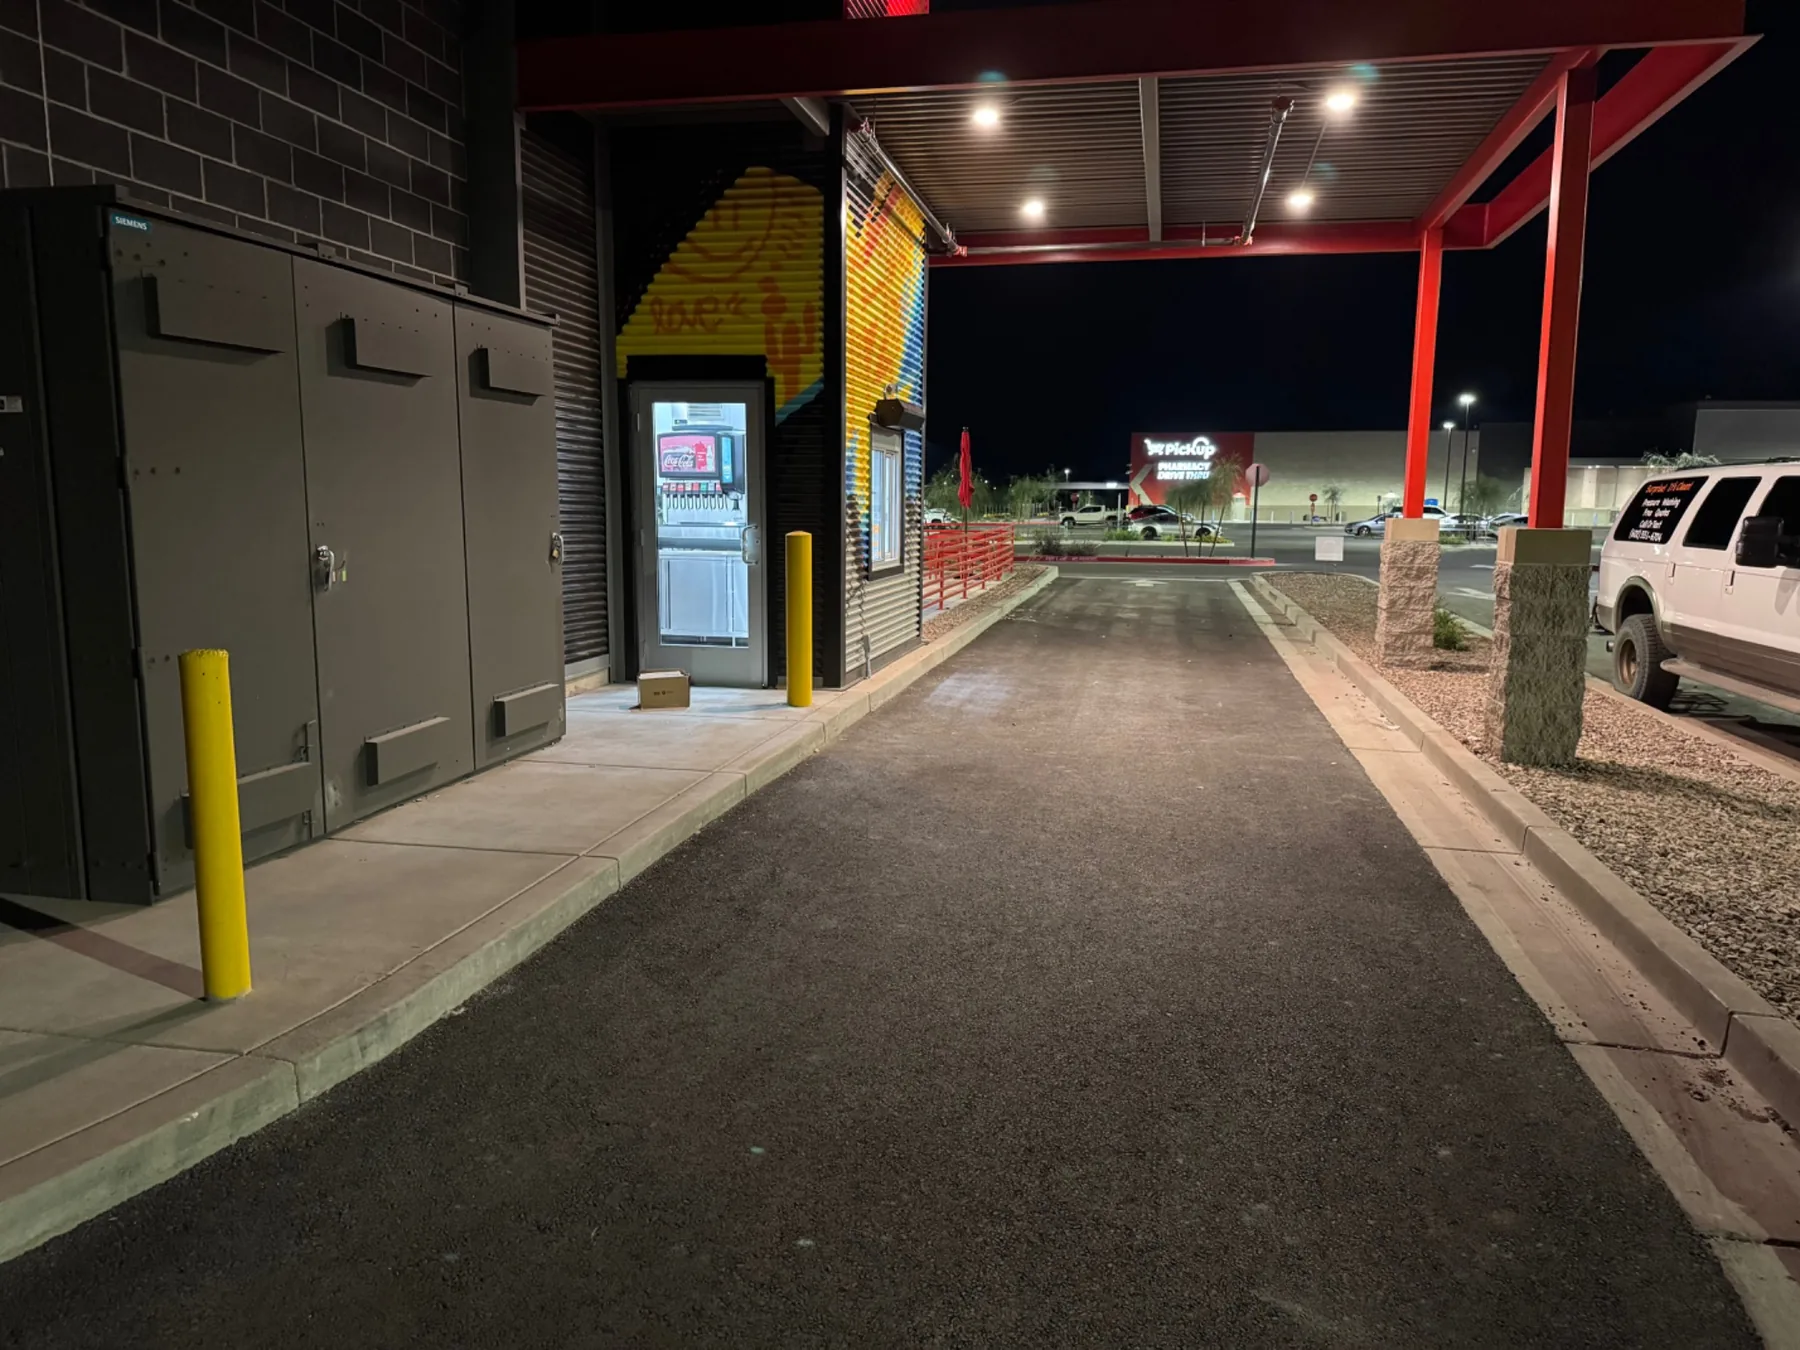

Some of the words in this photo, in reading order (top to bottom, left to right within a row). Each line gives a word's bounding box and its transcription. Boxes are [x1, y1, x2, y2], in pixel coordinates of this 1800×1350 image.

[115, 216, 148, 230] SIEMENS
[1158, 462, 1211, 471] PHARMACY
[1157, 471, 1185, 480] DRIVE
[1186, 471, 1210, 480] THRU
